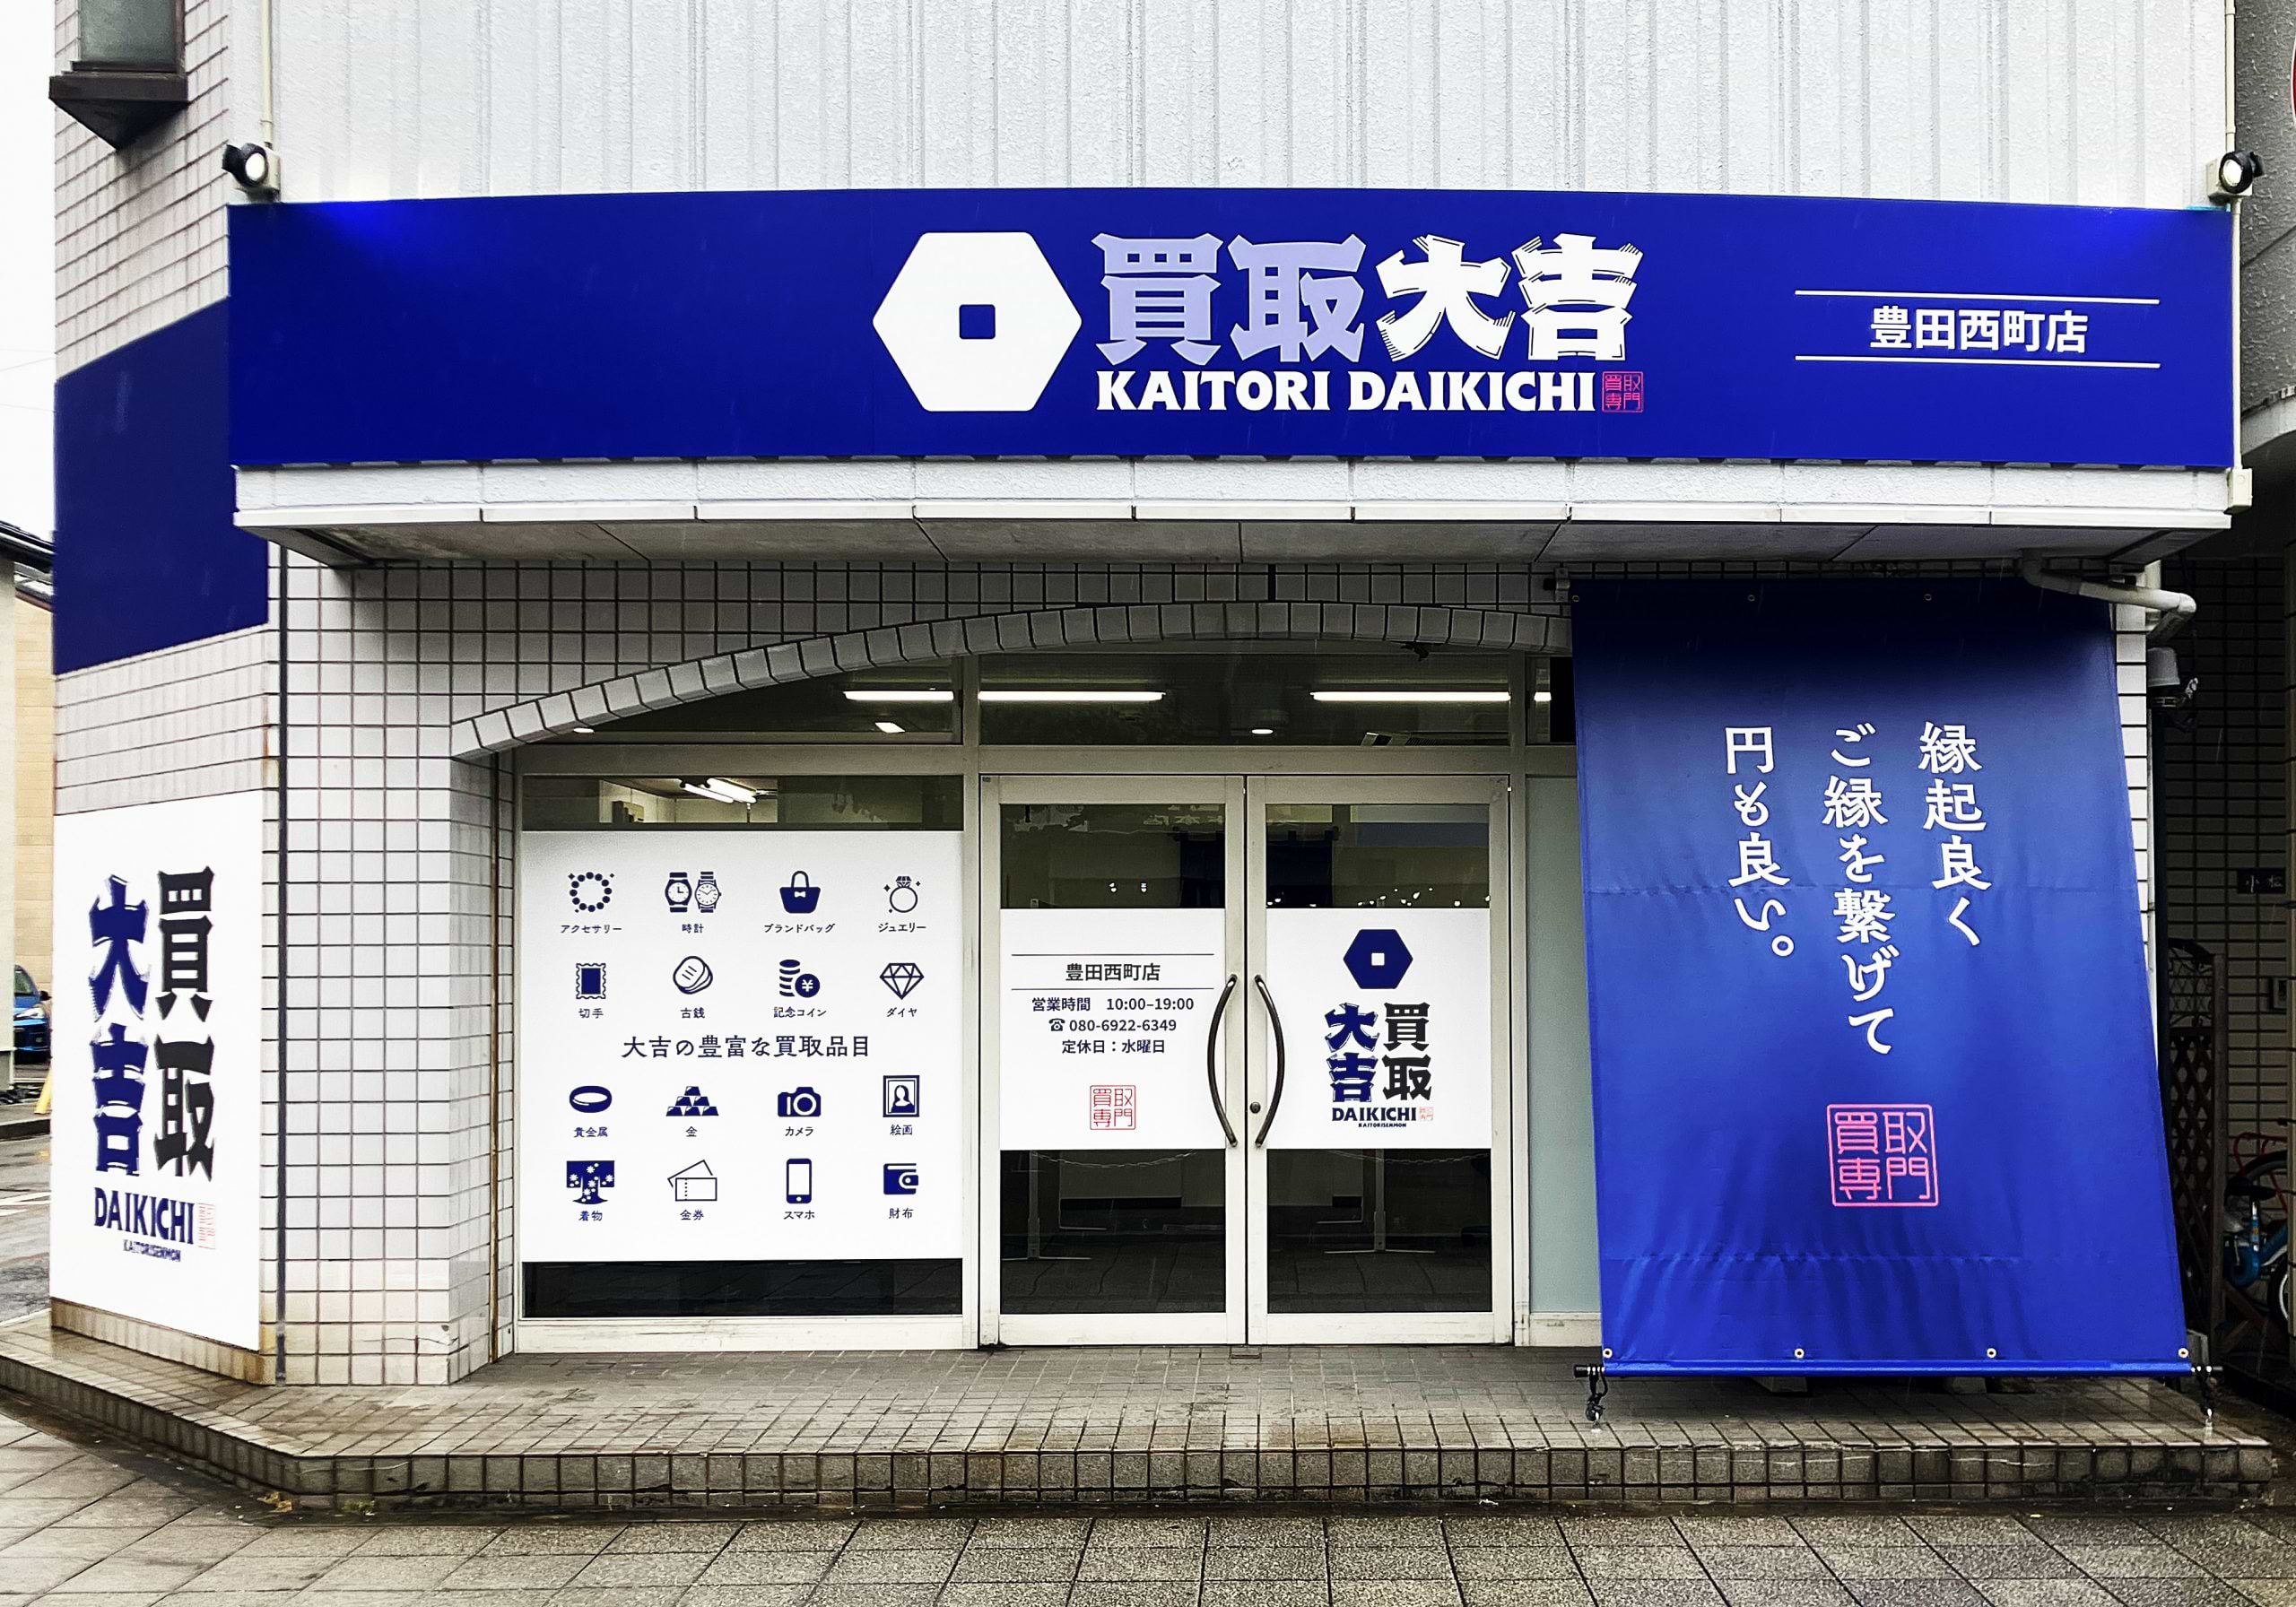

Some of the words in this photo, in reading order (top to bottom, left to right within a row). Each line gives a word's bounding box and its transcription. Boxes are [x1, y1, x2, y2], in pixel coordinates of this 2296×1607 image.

[1091, 233, 1644, 365] 買取大吉
[1870, 305, 2089, 353] 豊田西町店
[1097, 371, 1330, 410] KAITORI
[1348, 371, 1595, 411] DAIKICHI
[1918, 722, 1991, 945] 縁起良く
[1726, 727, 1794, 956] 円も良い。
[1822, 723, 1899, 1054] ご縁を繋げて
[561, 925, 622, 934] アクセサリー
[683, 924, 703, 934] 時計
[764, 924, 835, 933] ブランドバッグ
[878, 923, 926, 933] ジュエリー
[1065, 963, 1161, 981] 豊田西町店
[1032, 997, 1090, 1012] 営業時間
[578, 1008, 603, 1019] 切手
[681, 1007, 705, 1018] 古銭
[774, 1007, 826, 1018] 記念コイン
[887, 1007, 917, 1017] ダイヤ
[88, 873, 150, 1177] 大吉
[154, 866, 214, 1181] 買取
[1069, 1020, 1176, 1031] 080-6922-6349
[622, 1035, 868, 1057] 大吉の豊富な買取品目
[1382, 1003, 1431, 1100] 買取
[1325, 1003, 1379, 1102] 大吉
[1332, 1108, 1416, 1121] DAIKICHI
[574, 1127, 607, 1137] 貴金属
[686, 1126, 697, 1137] 金
[786, 1126, 813, 1136] カメラ
[890, 1125, 912, 1135] 絵画
[1834, 1110, 1929, 1155] 買取
[94, 1187, 195, 1245] DAIKICHI
[579, 1211, 603, 1221] 着物
[680, 1210, 703, 1220] 金券
[784, 1211, 814, 1220] スマホ
[889, 1208, 913, 1219] 財布
